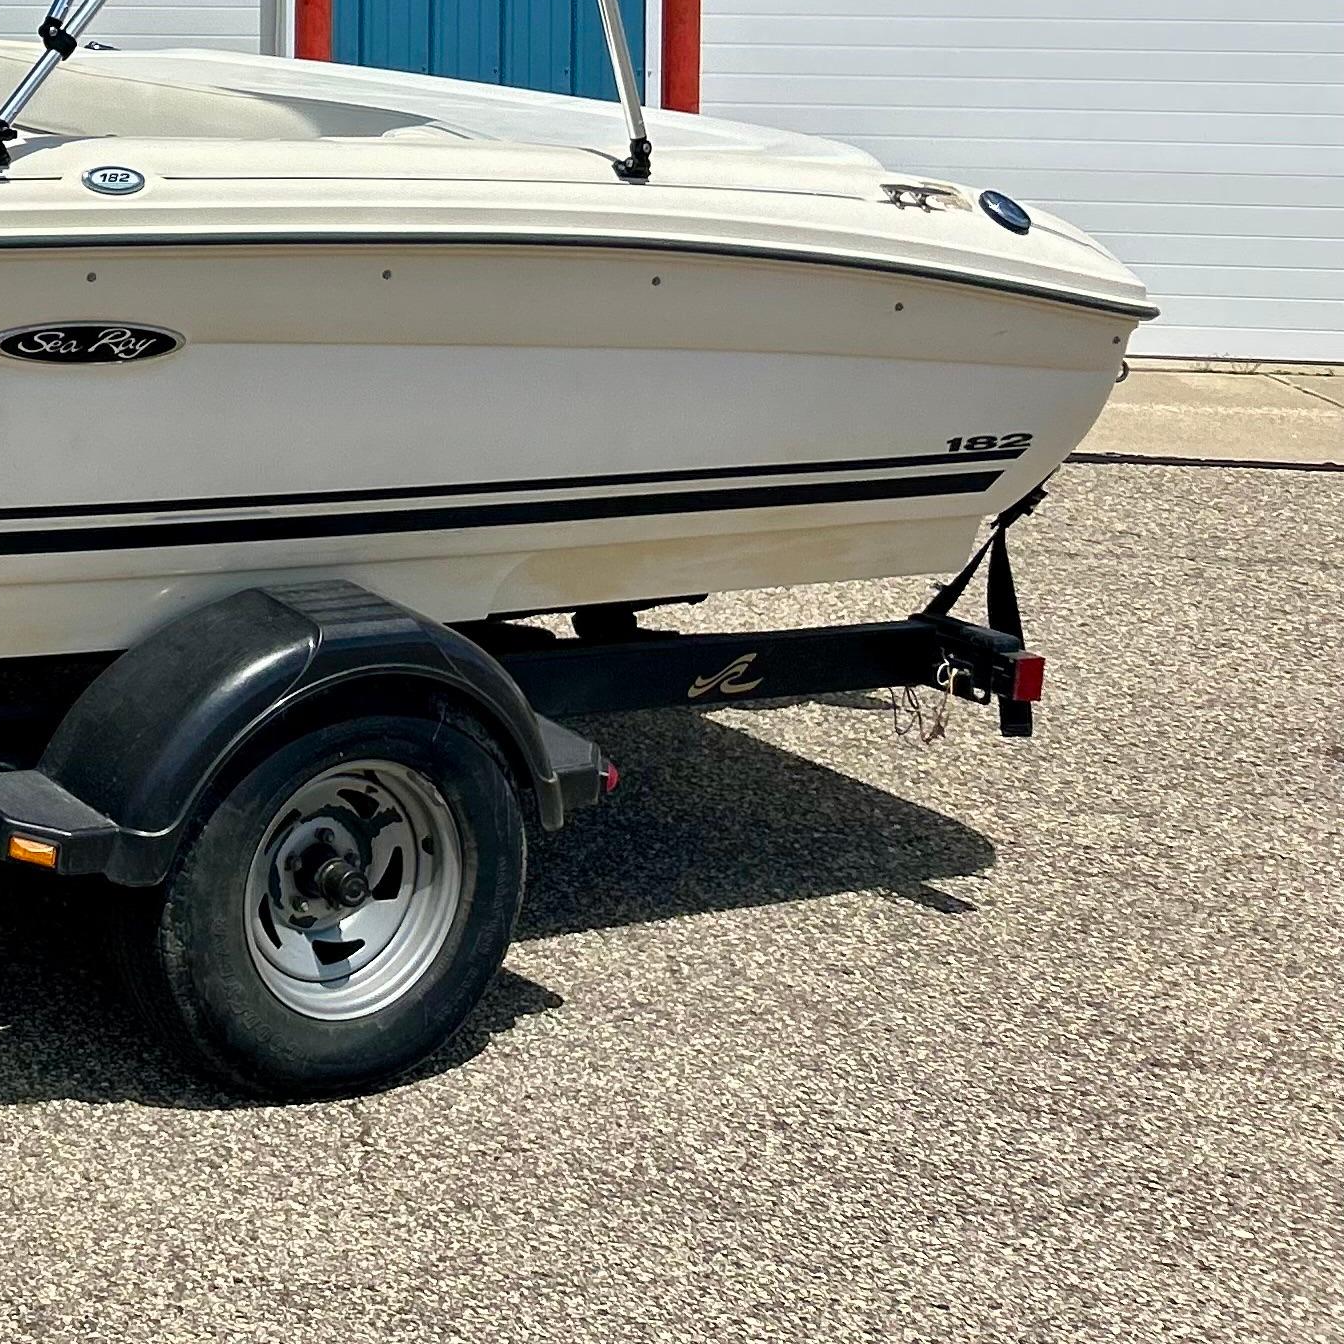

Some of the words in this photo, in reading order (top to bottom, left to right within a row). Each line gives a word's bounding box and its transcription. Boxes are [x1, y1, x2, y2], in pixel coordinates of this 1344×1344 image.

[99, 173, 130, 183] 182
[17, 331, 83, 353] Sea
[87, 328, 157, 358] Ray
[946, 433, 1034, 452] 182
